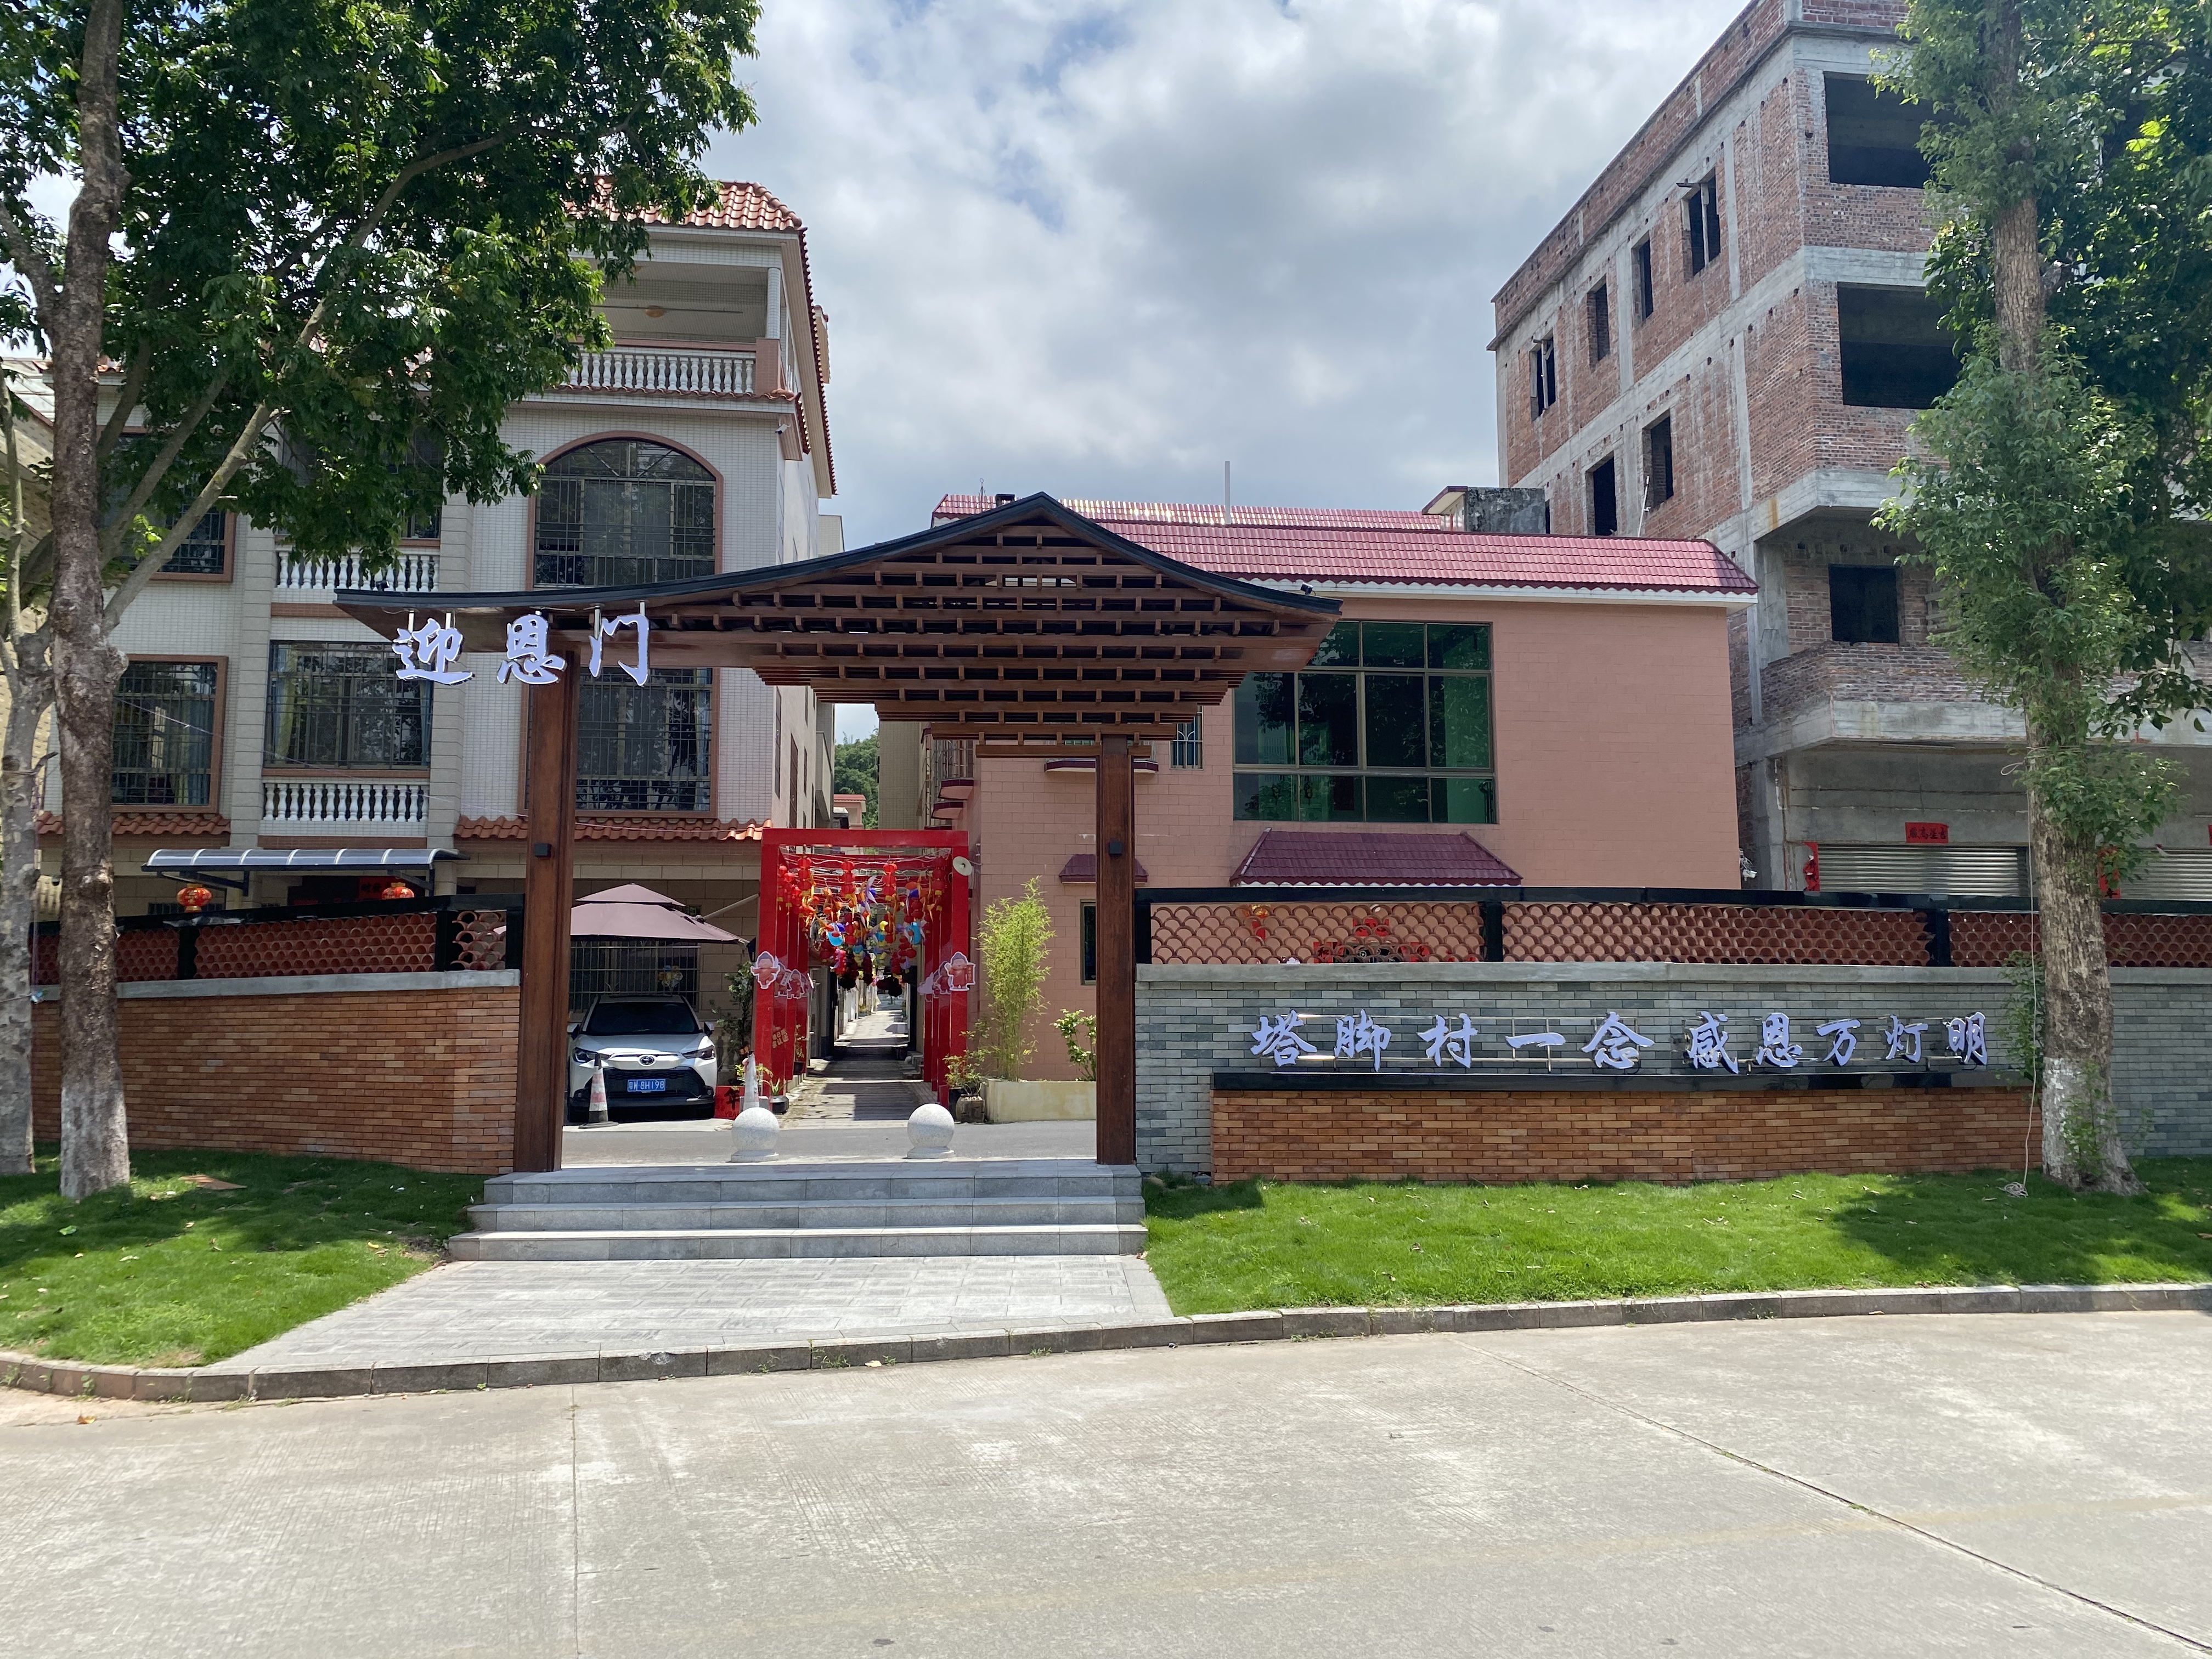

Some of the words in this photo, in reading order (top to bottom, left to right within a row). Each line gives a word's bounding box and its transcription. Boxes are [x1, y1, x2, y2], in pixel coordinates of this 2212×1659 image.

[392, 614, 650, 686] 迎恩门
[1250, 1009, 1988, 1074] 塔脚村一念感恩万灯明
